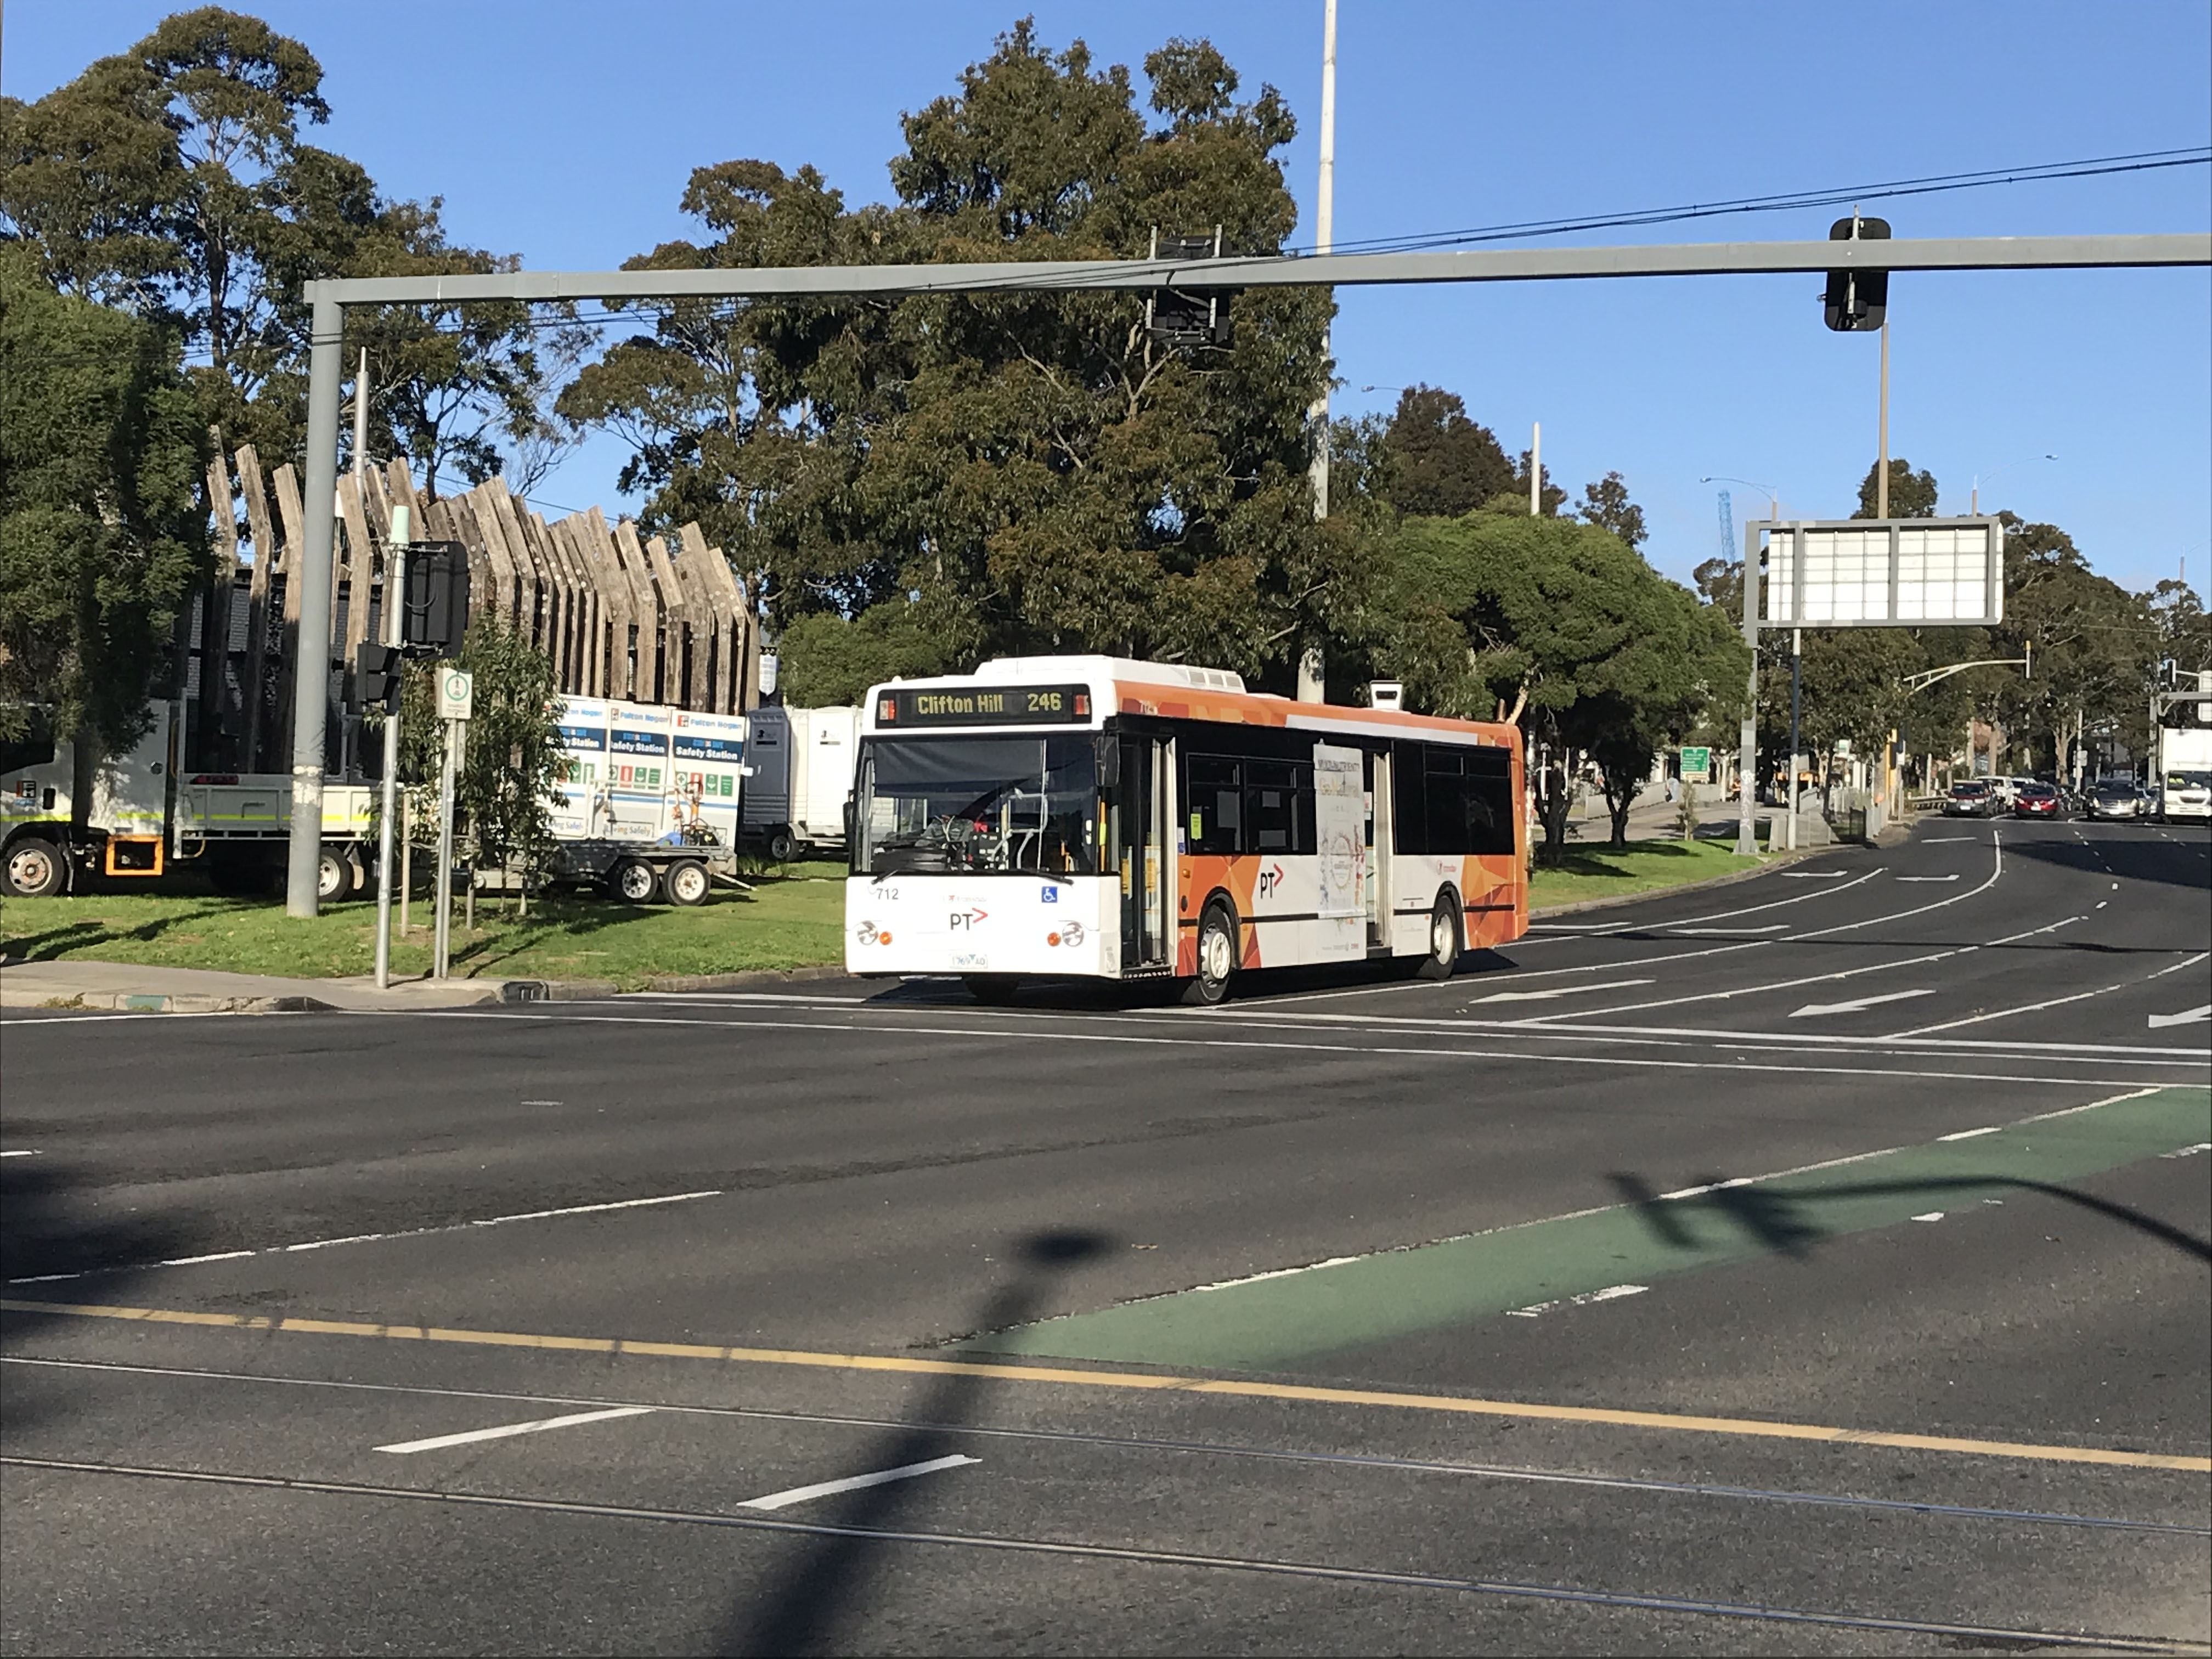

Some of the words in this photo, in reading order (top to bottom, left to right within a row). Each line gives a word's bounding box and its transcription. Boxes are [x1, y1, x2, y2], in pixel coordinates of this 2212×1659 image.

[918, 695, 973, 714] Clifton
[978, 694, 1003, 713] Hill
[1028, 692, 1062, 712] 246
[635, 742, 665, 753] Station
[676, 746, 706, 758] Safety
[706, 749, 737, 760] Station
[877, 888, 899, 900] 712
